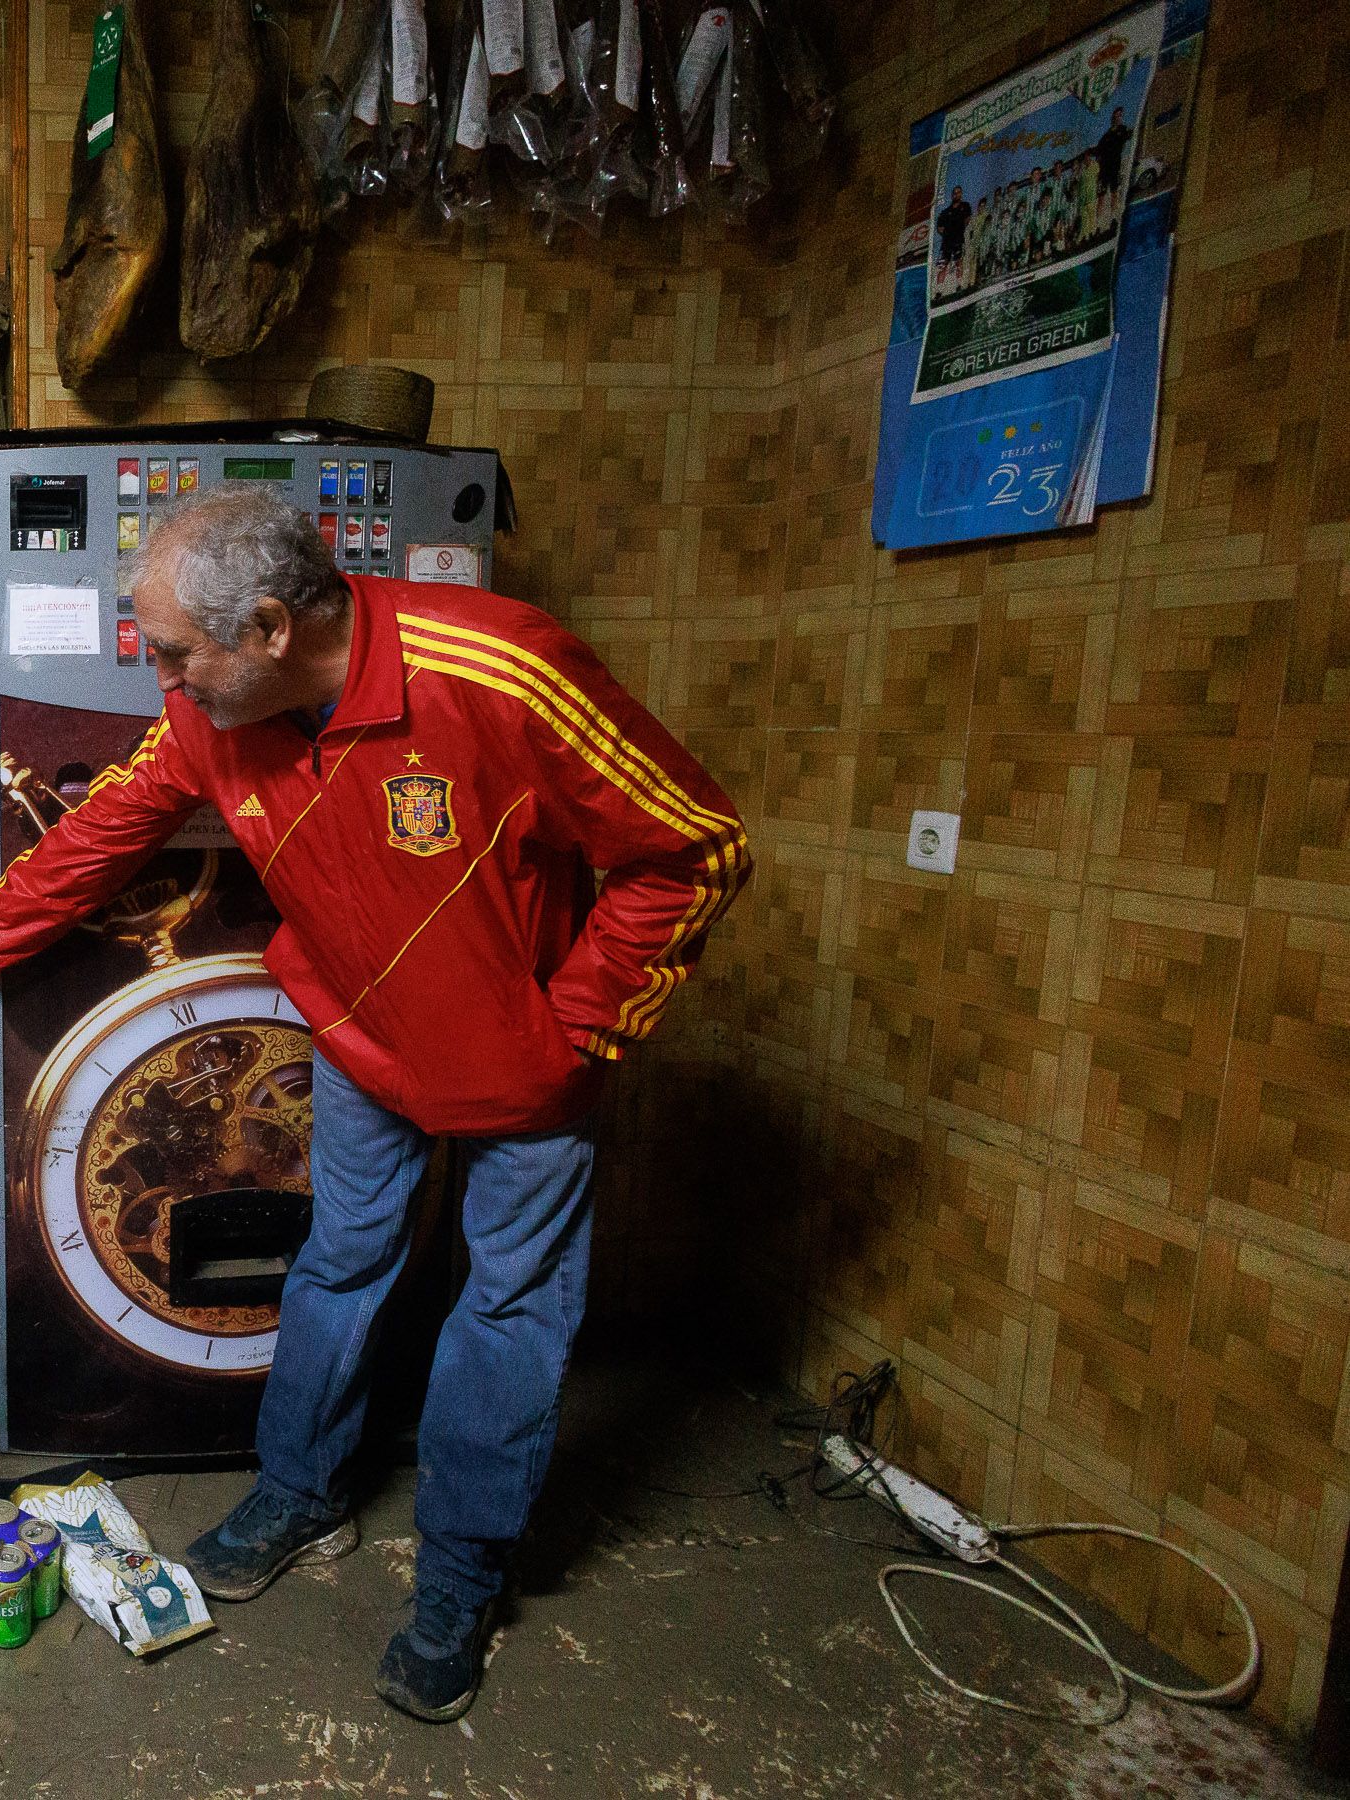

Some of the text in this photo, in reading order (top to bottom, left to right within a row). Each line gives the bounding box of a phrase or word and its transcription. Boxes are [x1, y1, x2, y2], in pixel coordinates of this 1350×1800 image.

[940, 320, 1089, 382] FOREVER GREEN
[1001, 445, 1036, 460] FELIZ
[236, 807, 265, 817] adidas
[168, 1001, 198, 1029] XII
